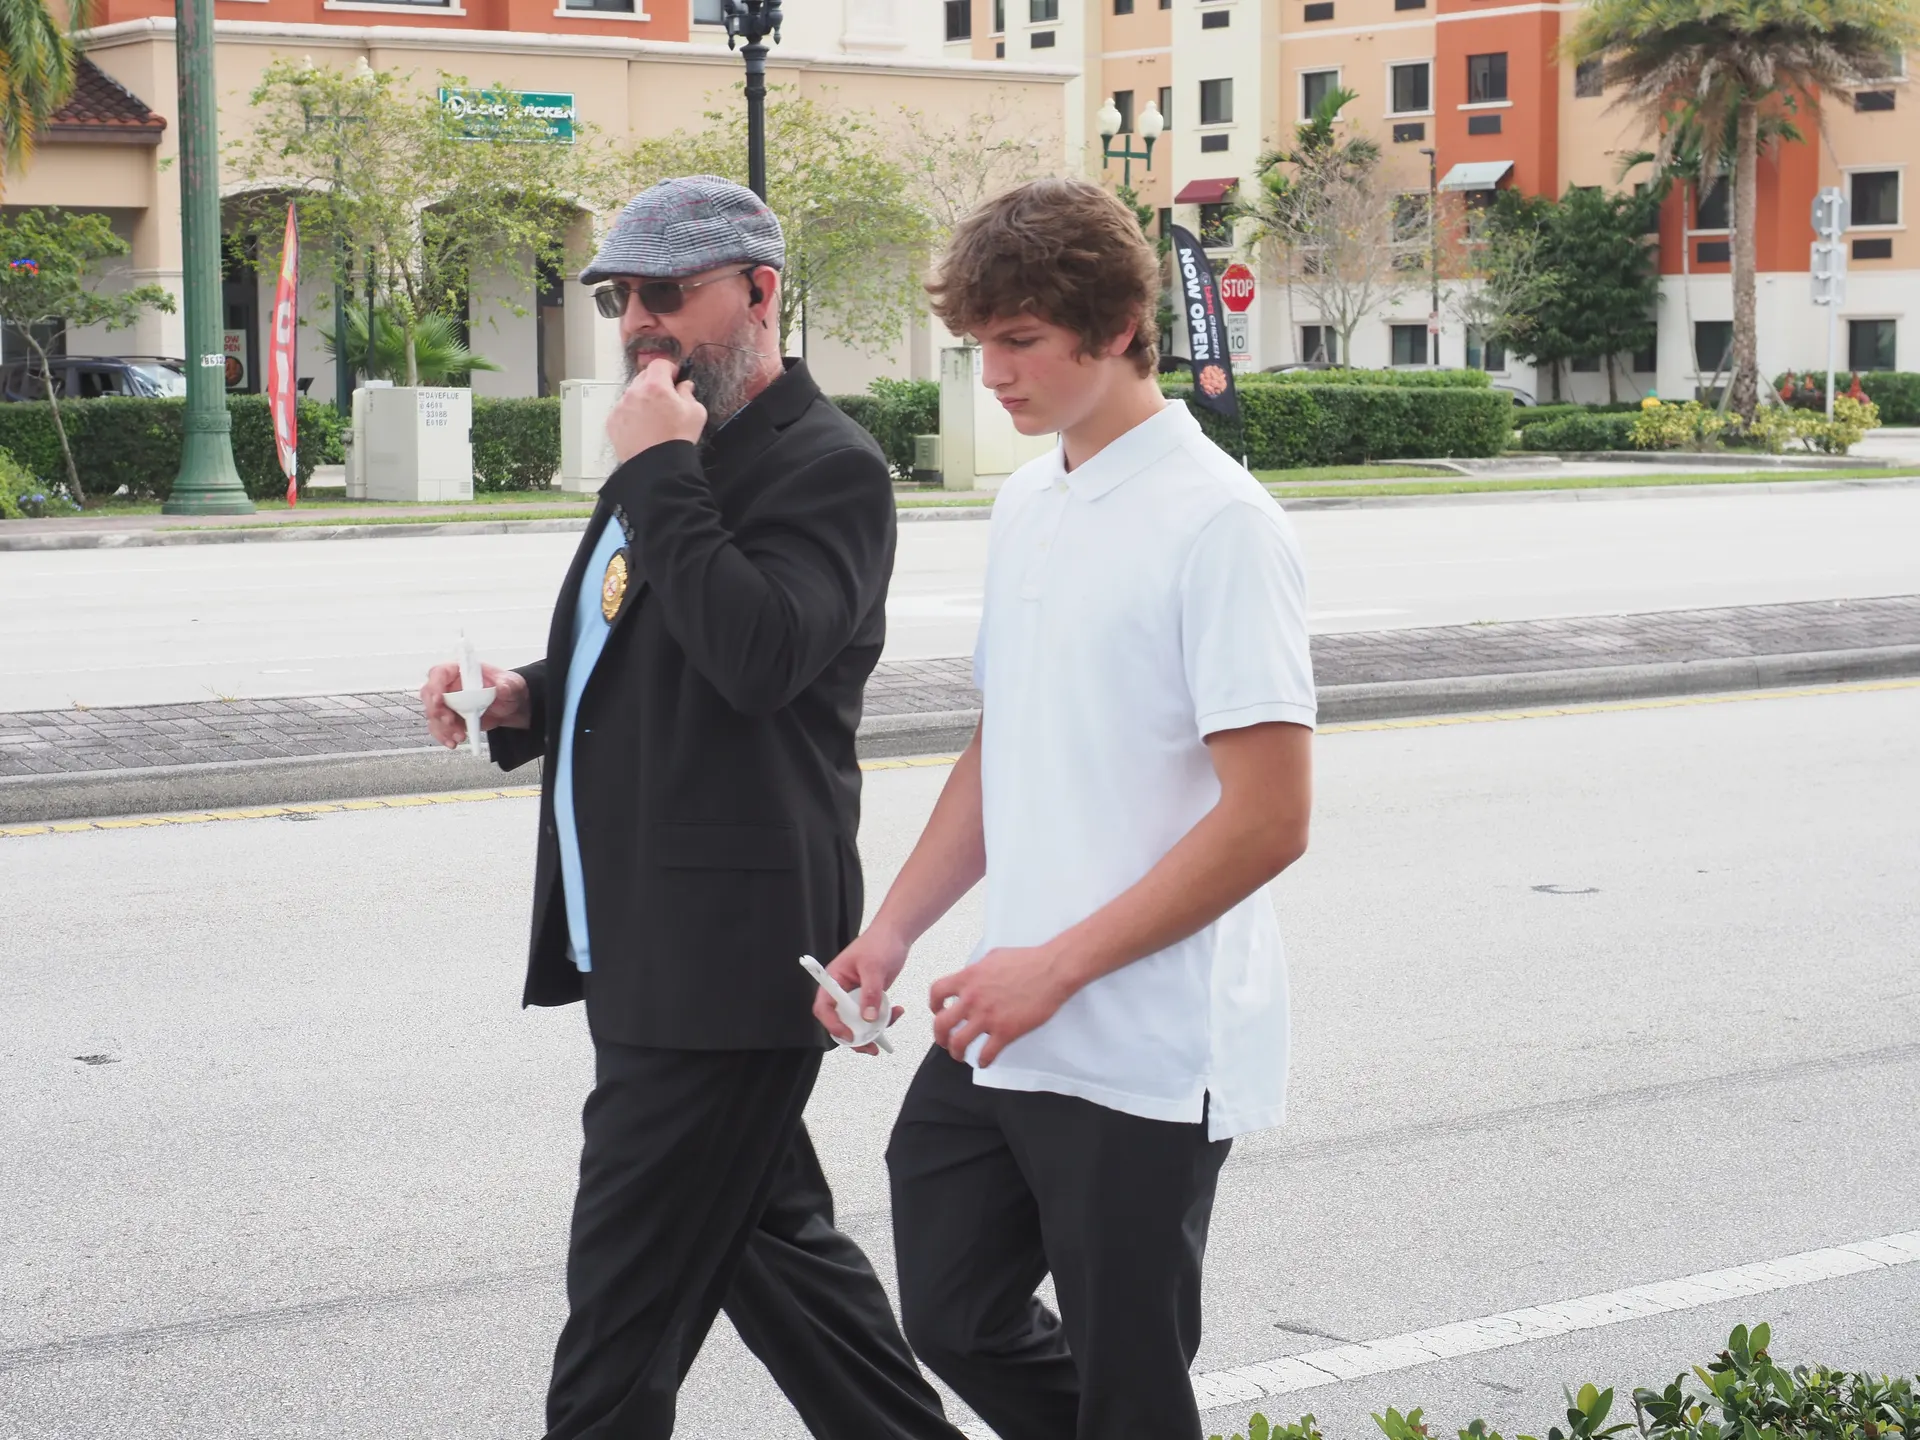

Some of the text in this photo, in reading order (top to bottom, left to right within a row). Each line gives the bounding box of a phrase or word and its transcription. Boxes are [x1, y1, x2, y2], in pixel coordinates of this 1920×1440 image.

[1222, 279, 1254, 298] STOP
[1180, 248, 1210, 360] NOW OPEN
[1231, 335, 1245, 349] 10
